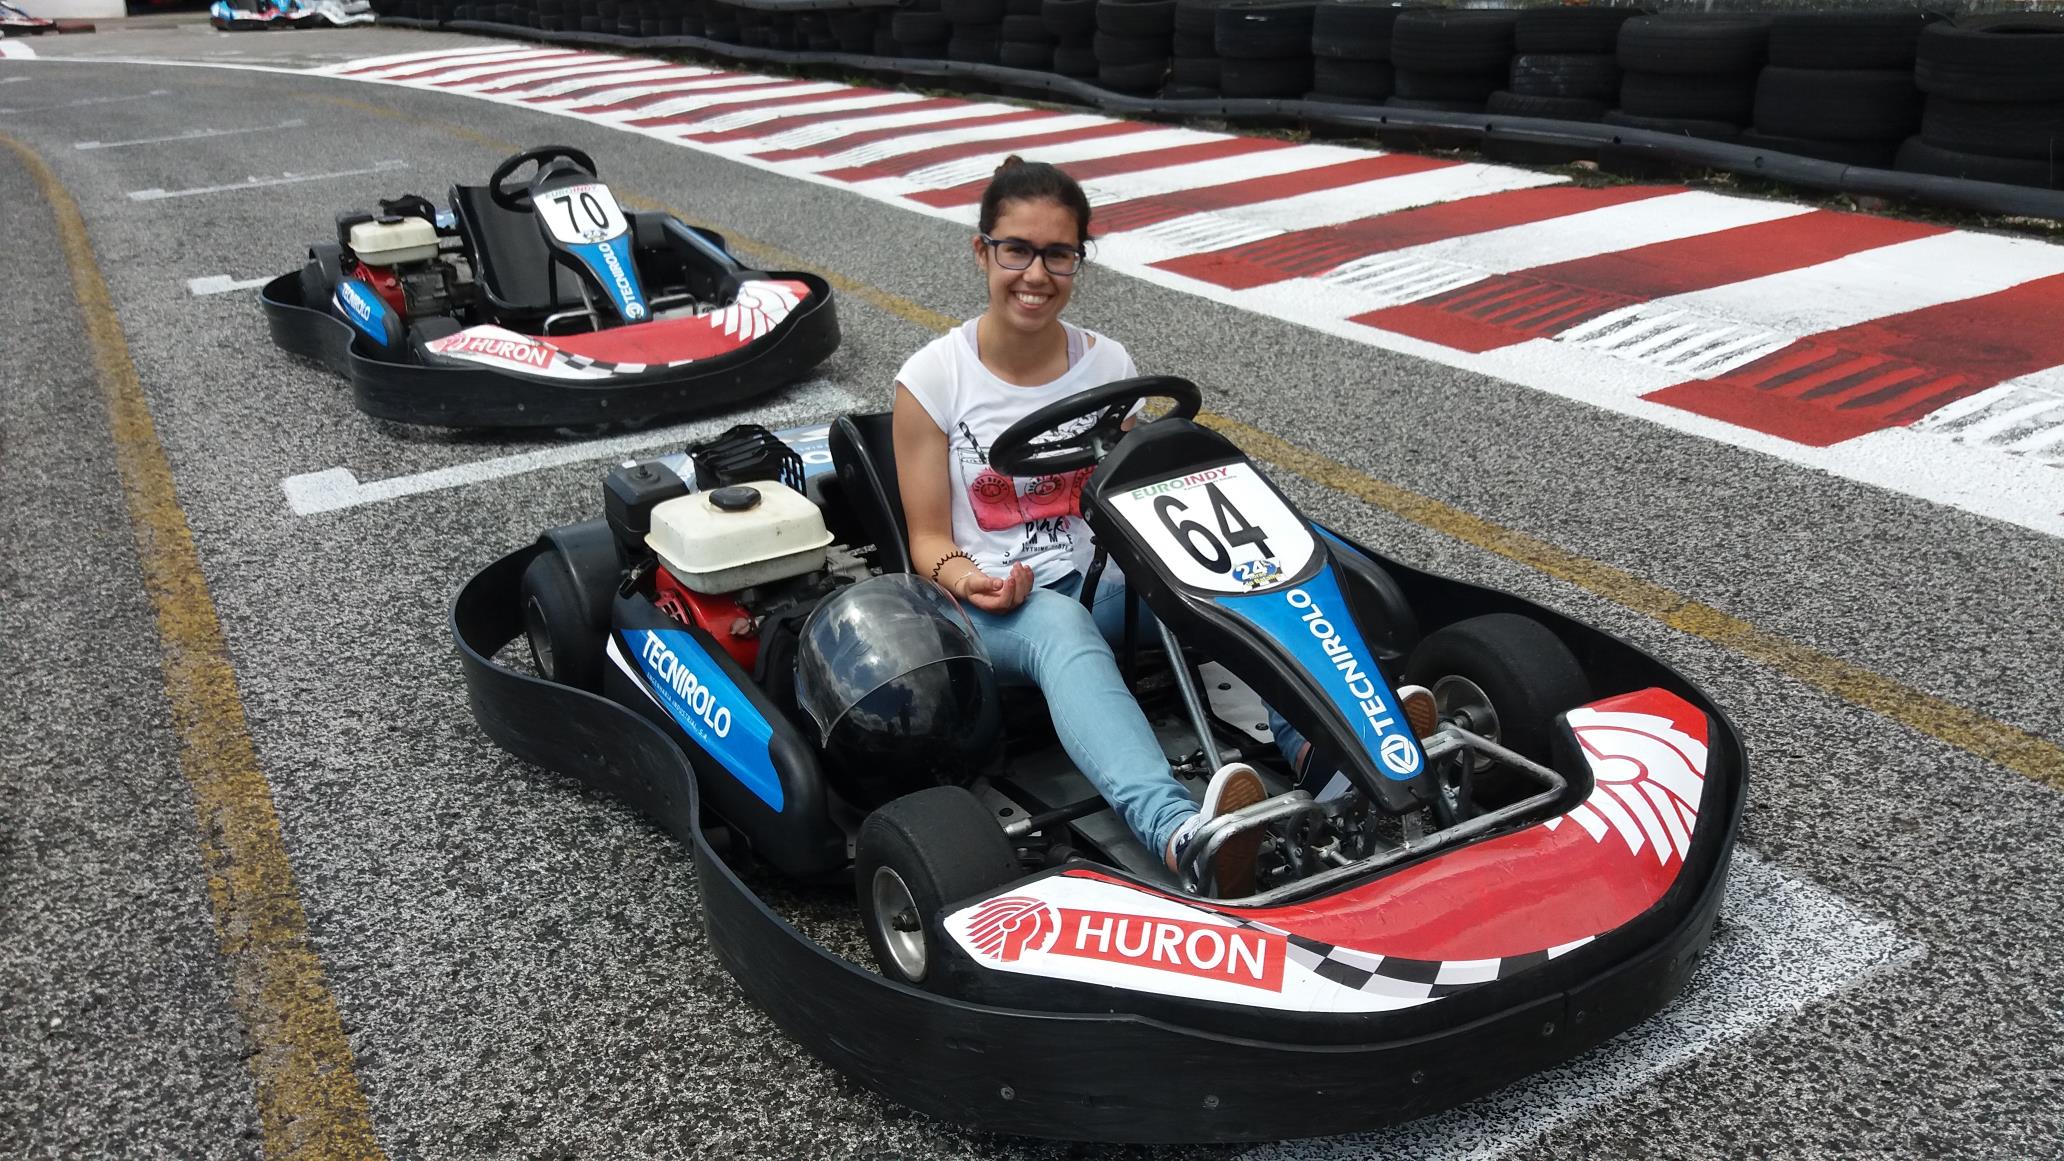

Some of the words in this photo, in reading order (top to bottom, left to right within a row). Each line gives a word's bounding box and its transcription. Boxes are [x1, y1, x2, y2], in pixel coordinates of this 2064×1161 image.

[553, 192, 610, 234] 70
[599, 242, 636, 304] TECNIROLO
[469, 337, 548, 366] HURON
[1131, 467, 1228, 501] EUROINDY
[1153, 481, 1276, 575] 64
[642, 629, 731, 738] TECNIROLO
[1286, 588, 1394, 736] TECNIROLO
[1074, 915, 1267, 980] HURON
